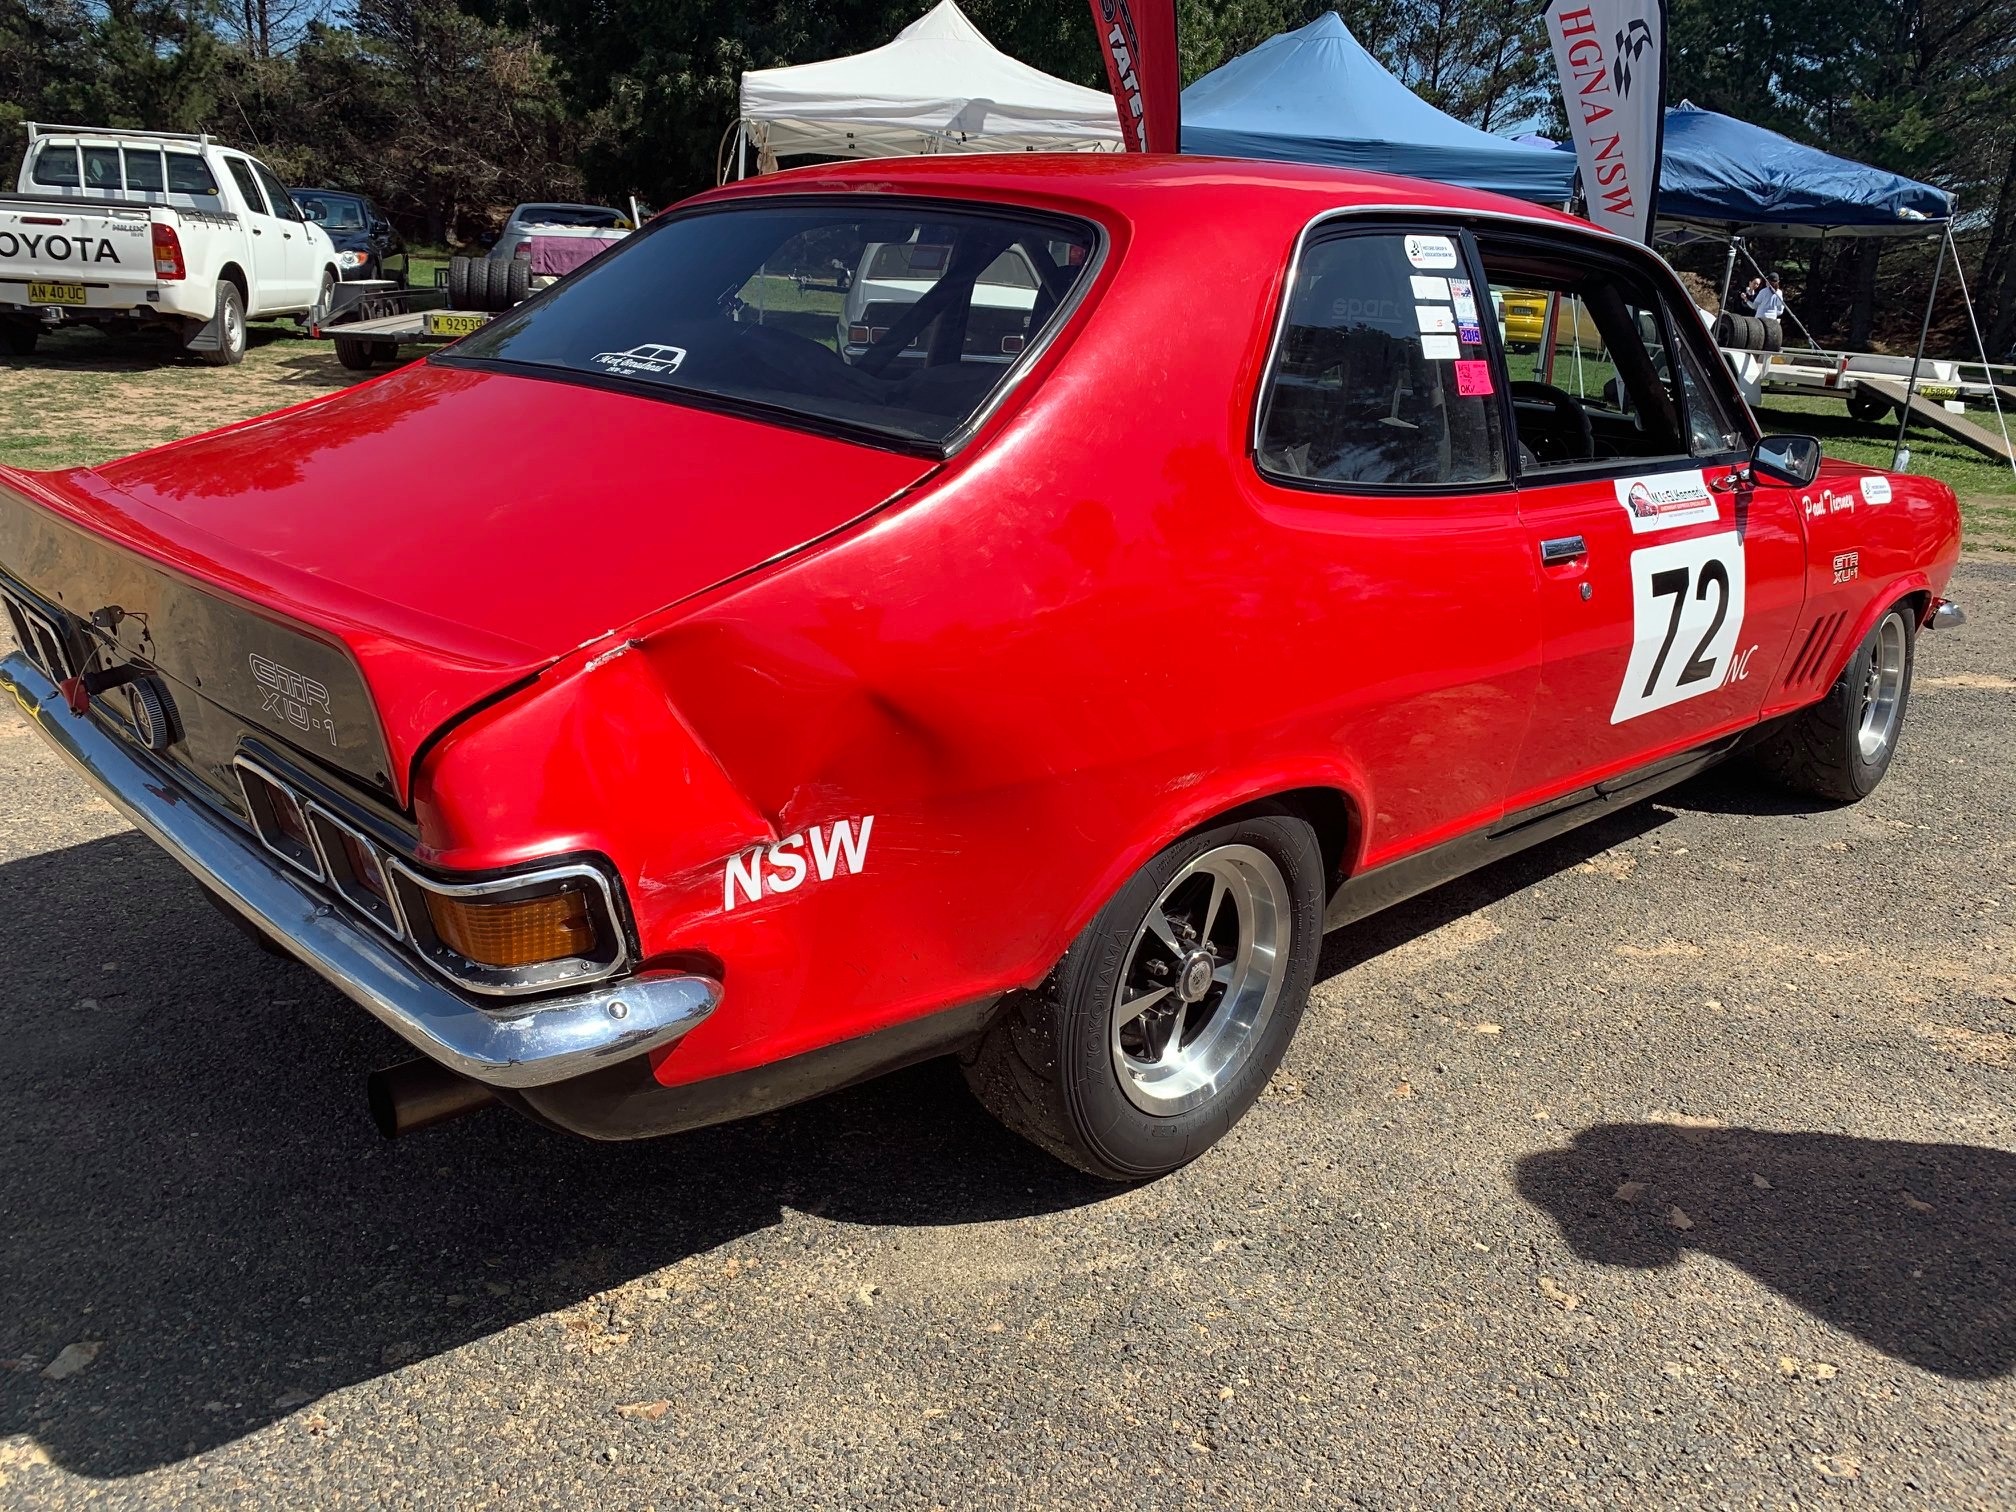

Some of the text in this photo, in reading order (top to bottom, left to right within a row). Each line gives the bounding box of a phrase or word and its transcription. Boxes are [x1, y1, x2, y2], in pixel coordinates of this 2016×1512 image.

[1558, 4, 1635, 218] HGNA NSW
[1461, 329, 1480, 342] 2019
[1802, 494, 1826, 522] Paul
[1833, 551, 1859, 570] GTR
[1641, 558, 1730, 699] 72
[249, 652, 331, 715] GTR
[1723, 644, 1759, 687] NC
[724, 814, 875, 912] NSW
[1087, 930, 1129, 1084] YOKOHAMA
